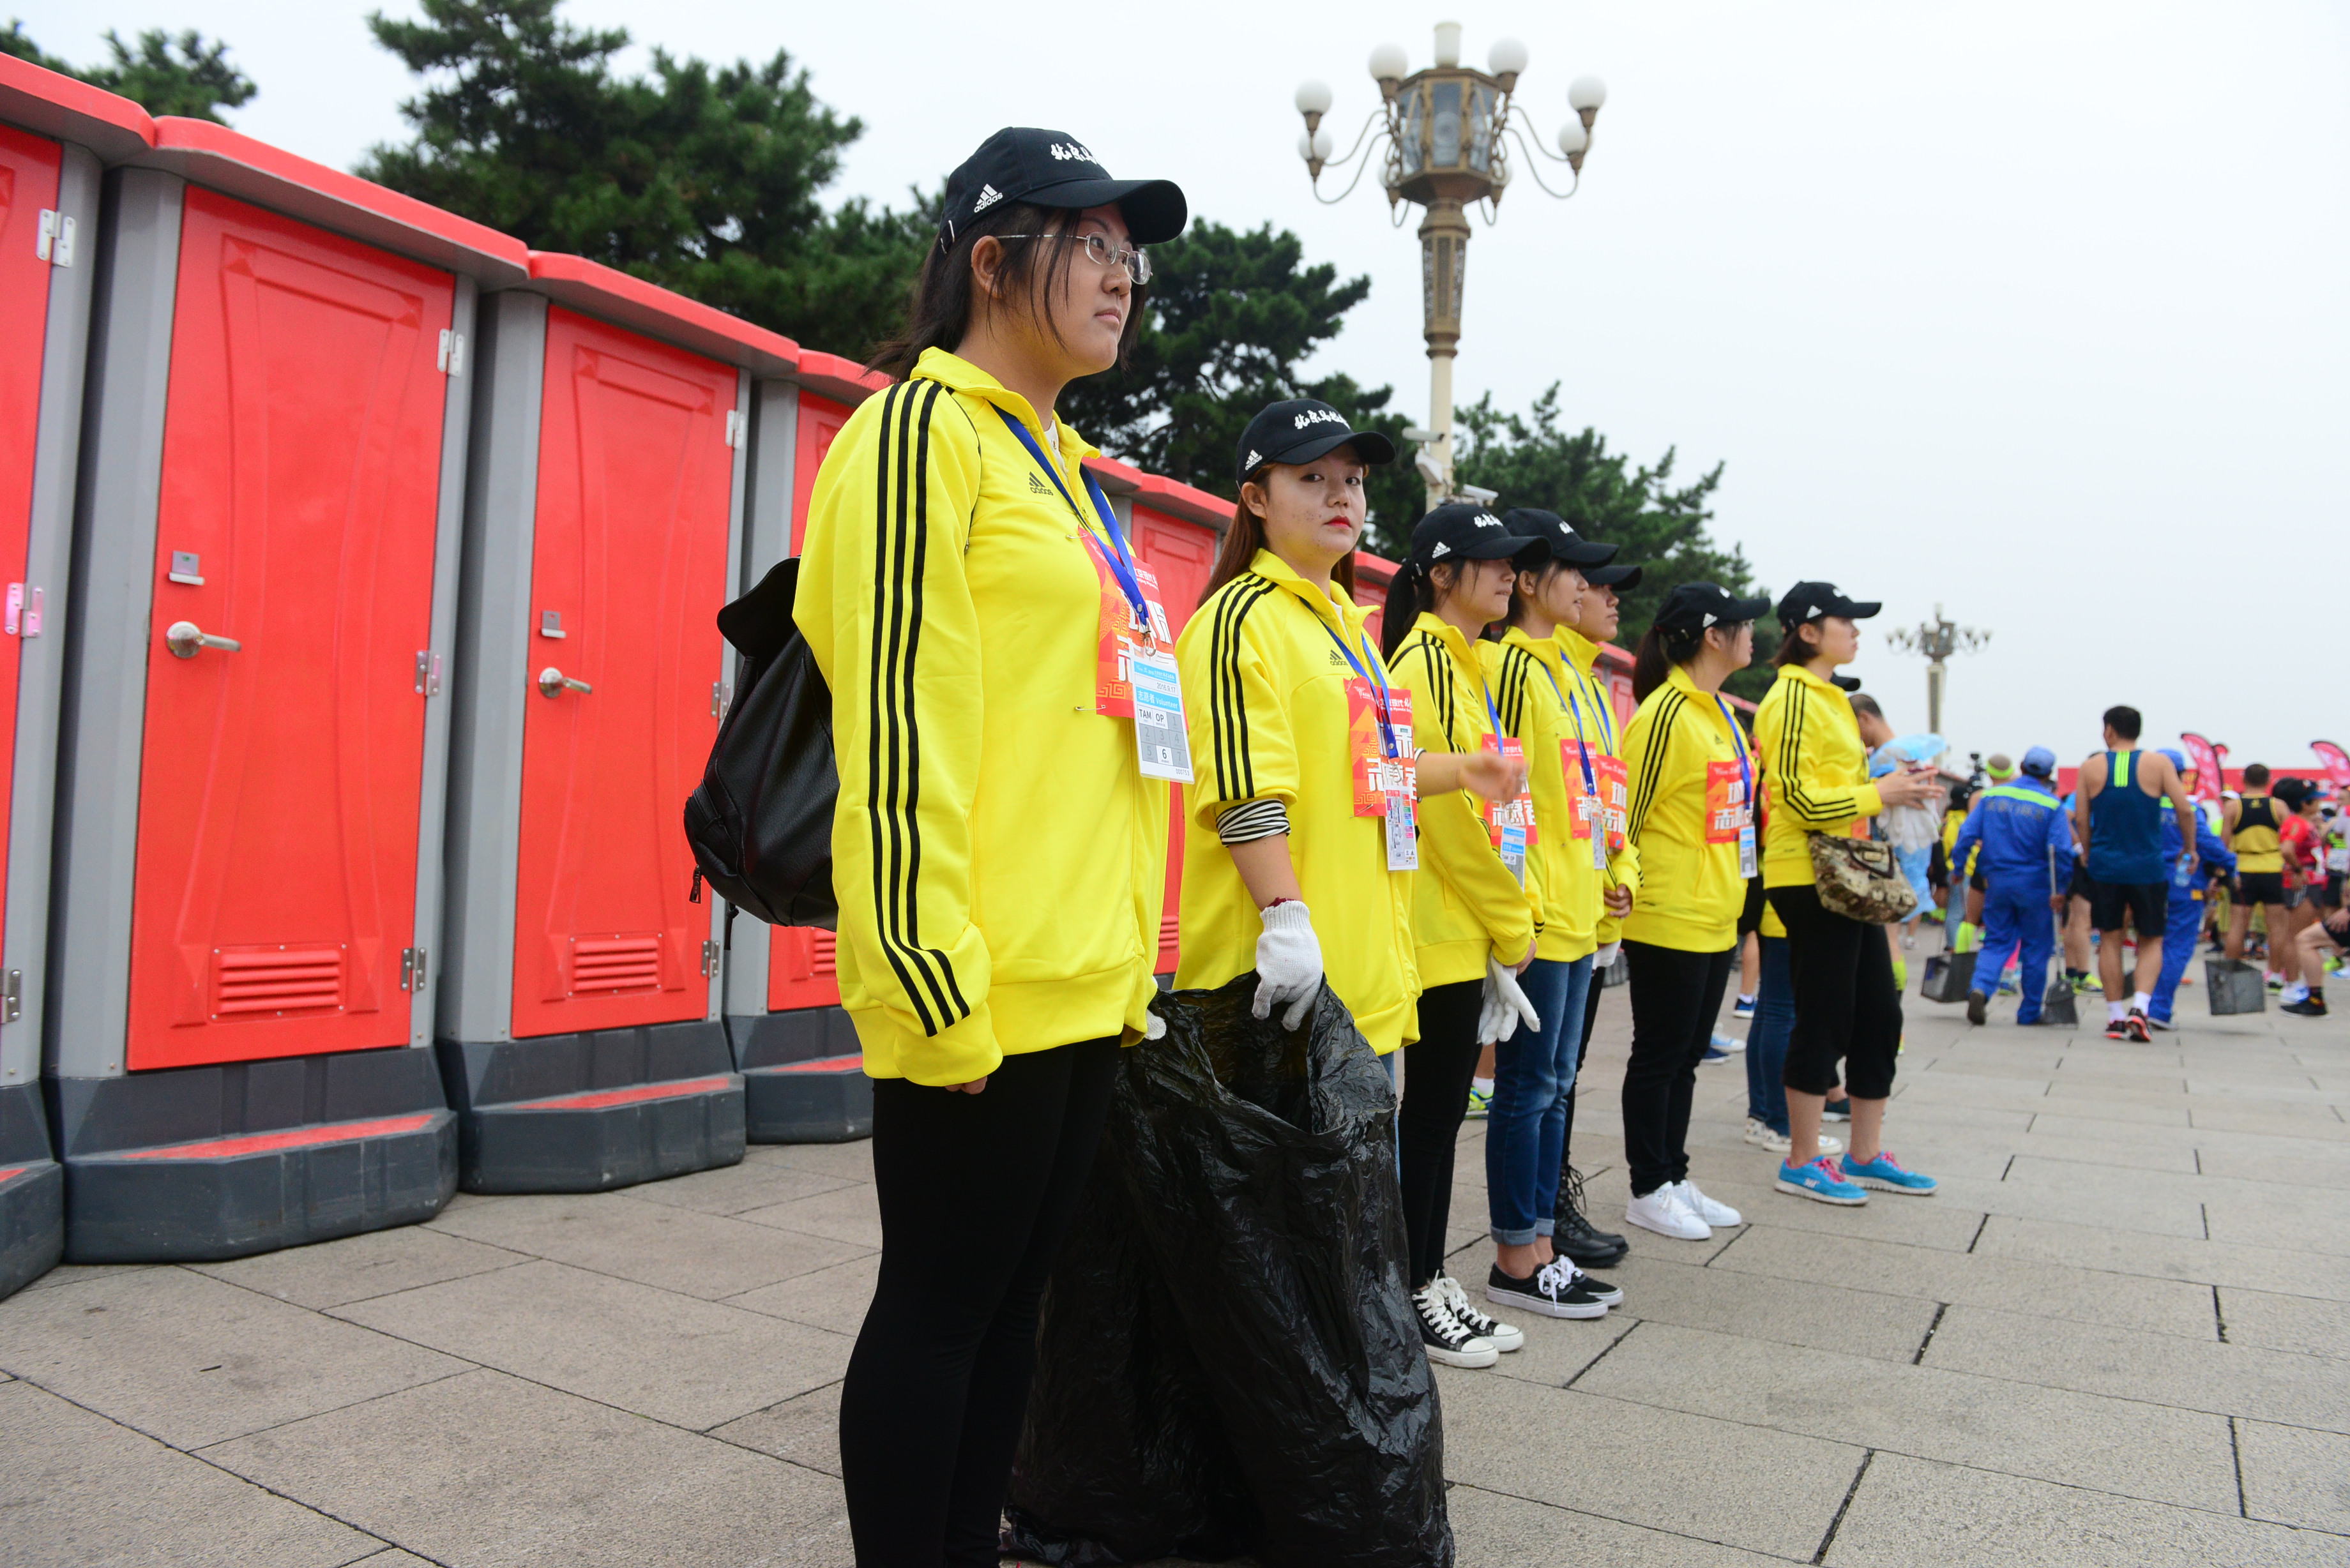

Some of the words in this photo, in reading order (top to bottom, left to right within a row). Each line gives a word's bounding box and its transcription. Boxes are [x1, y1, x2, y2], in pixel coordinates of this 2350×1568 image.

[974, 192, 1003, 213] adidas
[1156, 682, 1176, 693] 2016.9.17
[1155, 697, 1178, 709] Volunteer
[1139, 709, 1152, 720] TAM
[1155, 713, 1164, 723] OP
[1162, 748, 1167, 759] 6
